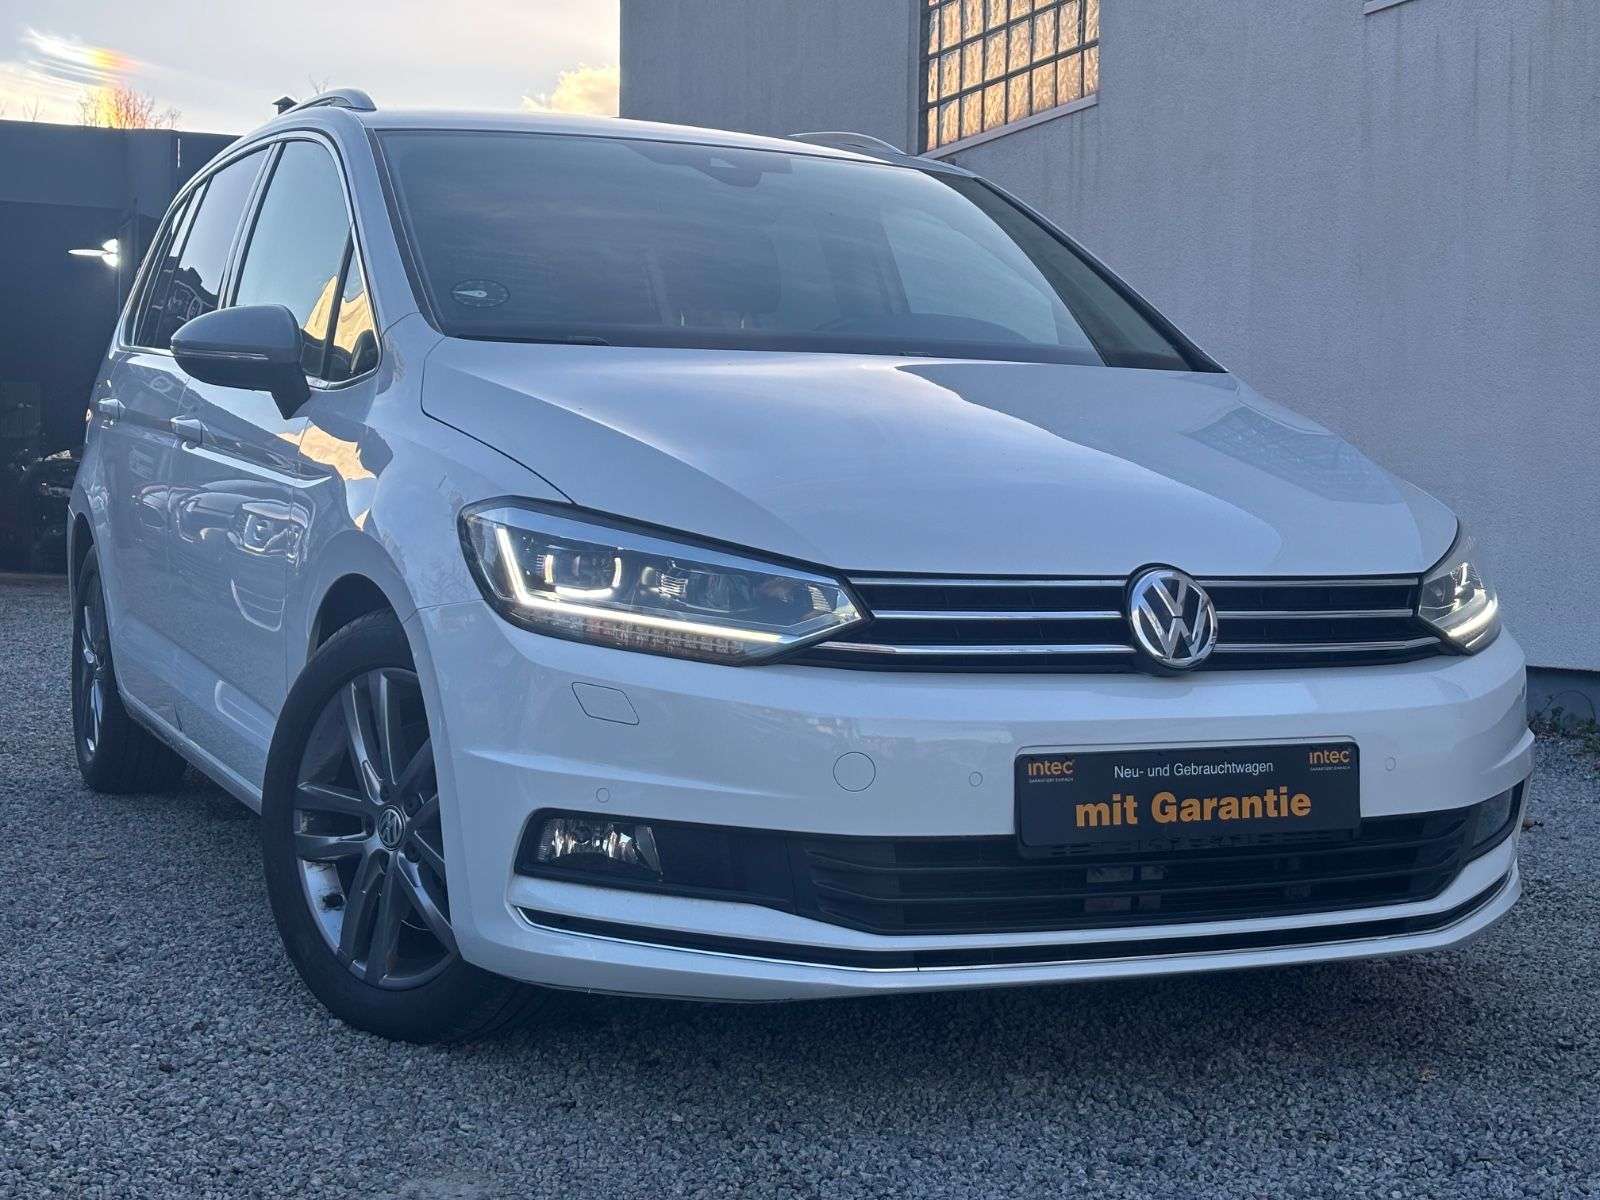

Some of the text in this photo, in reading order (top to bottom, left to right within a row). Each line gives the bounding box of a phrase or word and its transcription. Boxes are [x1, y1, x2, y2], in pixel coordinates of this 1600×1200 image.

[1131, 570, 1218, 668] VW
[1308, 750, 1350, 764] intec
[1028, 760, 1073, 776] intec
[1114, 761, 1274, 779] Neu- und Gebrauchtwagen
[1075, 786, 1312, 827] mit Garantie
